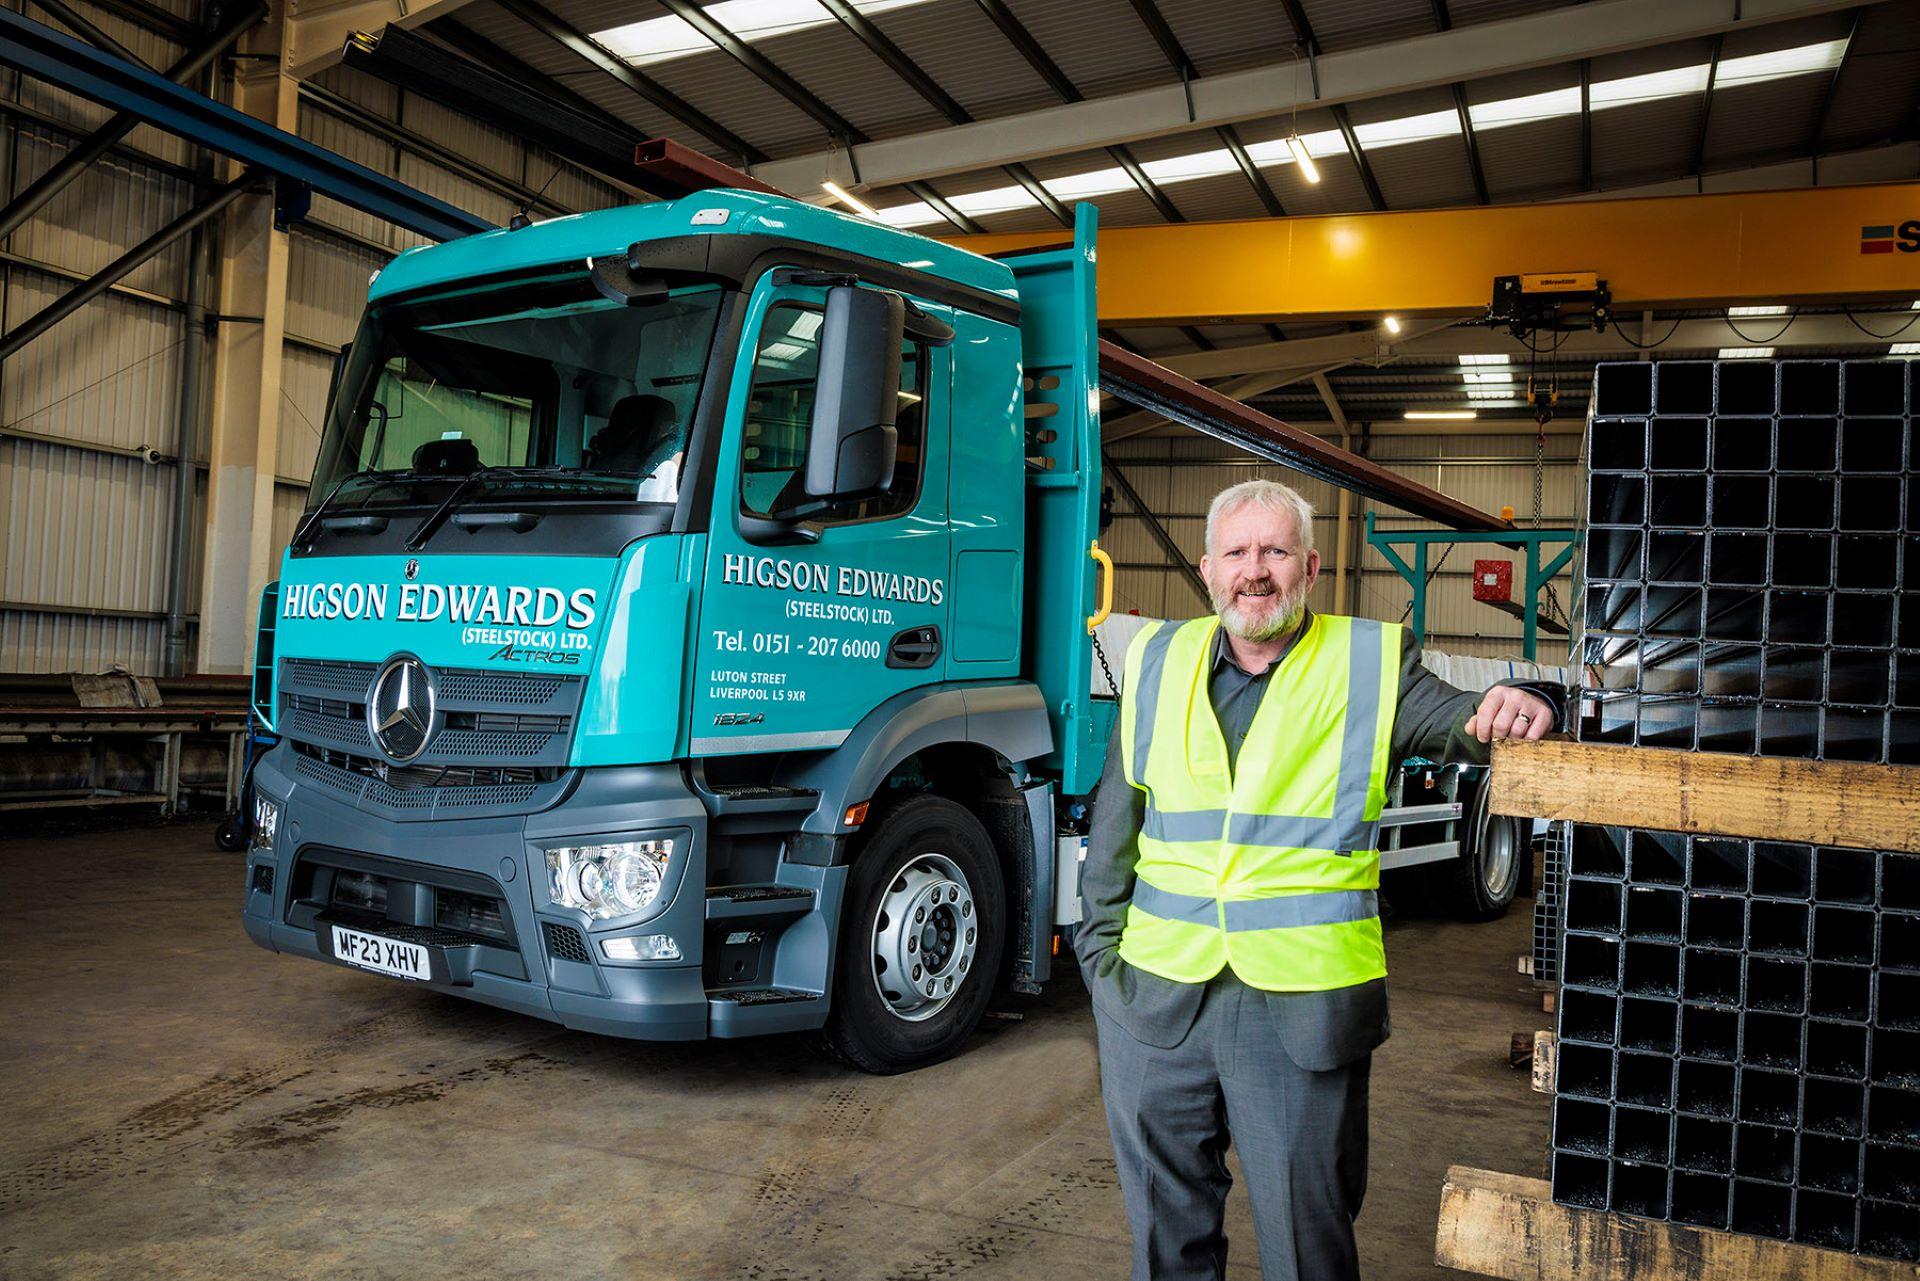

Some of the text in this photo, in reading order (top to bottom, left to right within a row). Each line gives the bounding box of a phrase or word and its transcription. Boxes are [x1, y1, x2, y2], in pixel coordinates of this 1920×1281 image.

[722, 553, 944, 606] HIGSON EDWARDS
[282, 583, 597, 629] HIGSON EDWARDS
[786, 599, 895, 626] (STEELSTOCK) LTD.
[462, 627, 593, 650] (STEELSTOCK) LTD.
[713, 629, 747, 652] Tel.
[752, 633, 790, 654] 0151
[808, 636, 838, 657] 207
[842, 638, 881, 659] 6000
[488, 644, 581, 665] ACTROS
[711, 670, 787, 685] LUTON STREET
[709, 686, 806, 702] LIVERPOOL L5 9XR
[713, 712, 765, 726] 1824
[339, 931, 381, 964] MF23
[385, 942, 419, 973] XHV
